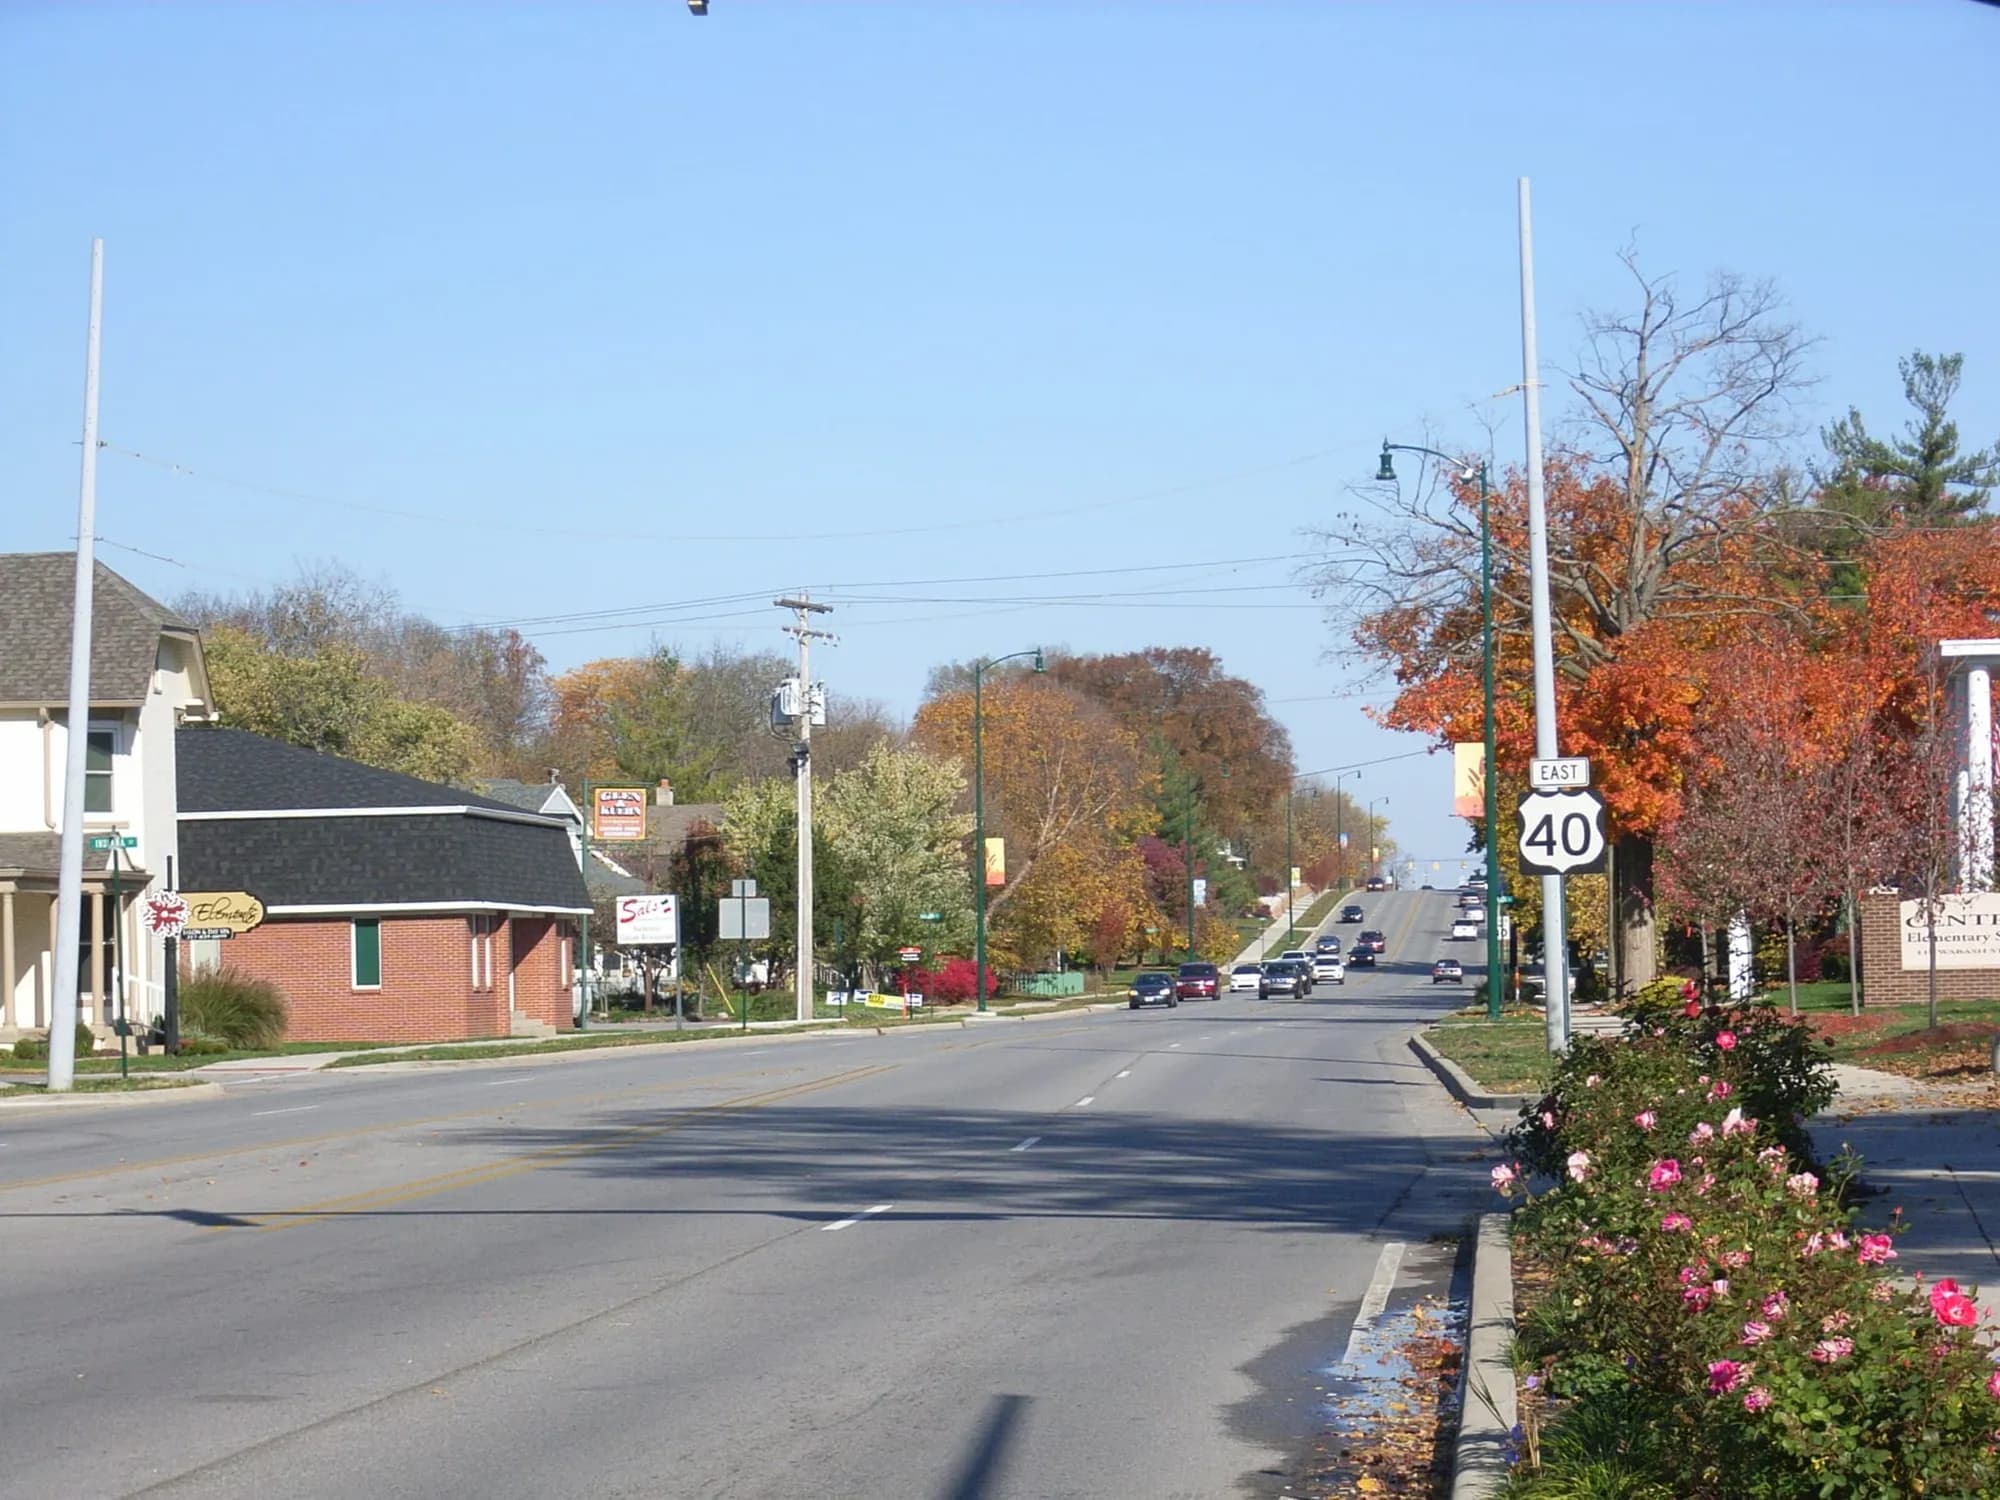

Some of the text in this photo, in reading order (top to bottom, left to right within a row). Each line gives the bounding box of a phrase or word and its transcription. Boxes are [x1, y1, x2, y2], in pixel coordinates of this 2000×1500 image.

[1540, 764, 1578, 781] EAST
[1525, 812, 1591, 857] 40
[191, 896, 258, 924] Elements
